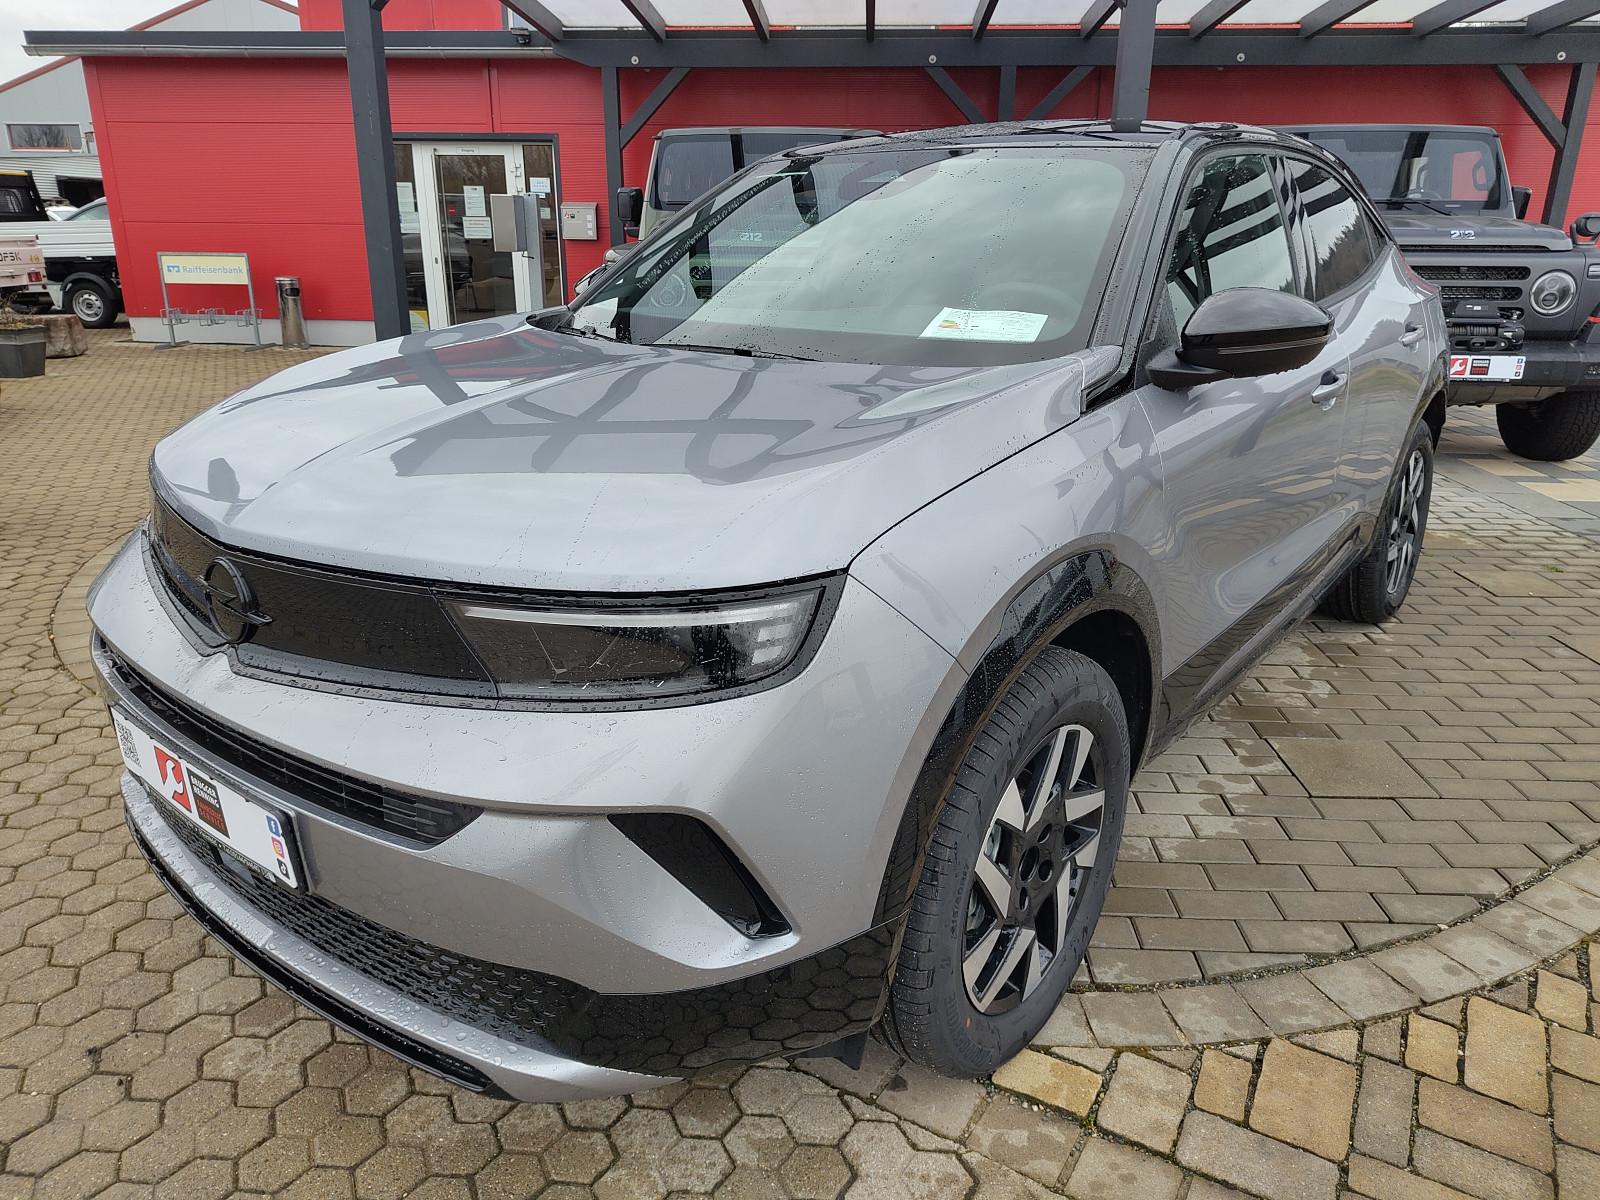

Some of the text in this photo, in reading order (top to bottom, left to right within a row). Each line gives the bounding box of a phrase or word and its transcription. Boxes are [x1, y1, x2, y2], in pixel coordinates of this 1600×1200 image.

[740, 232, 762, 241] 212
[1450, 230, 1475, 240] 212
[182, 265, 244, 274] Raiffeisenbank
